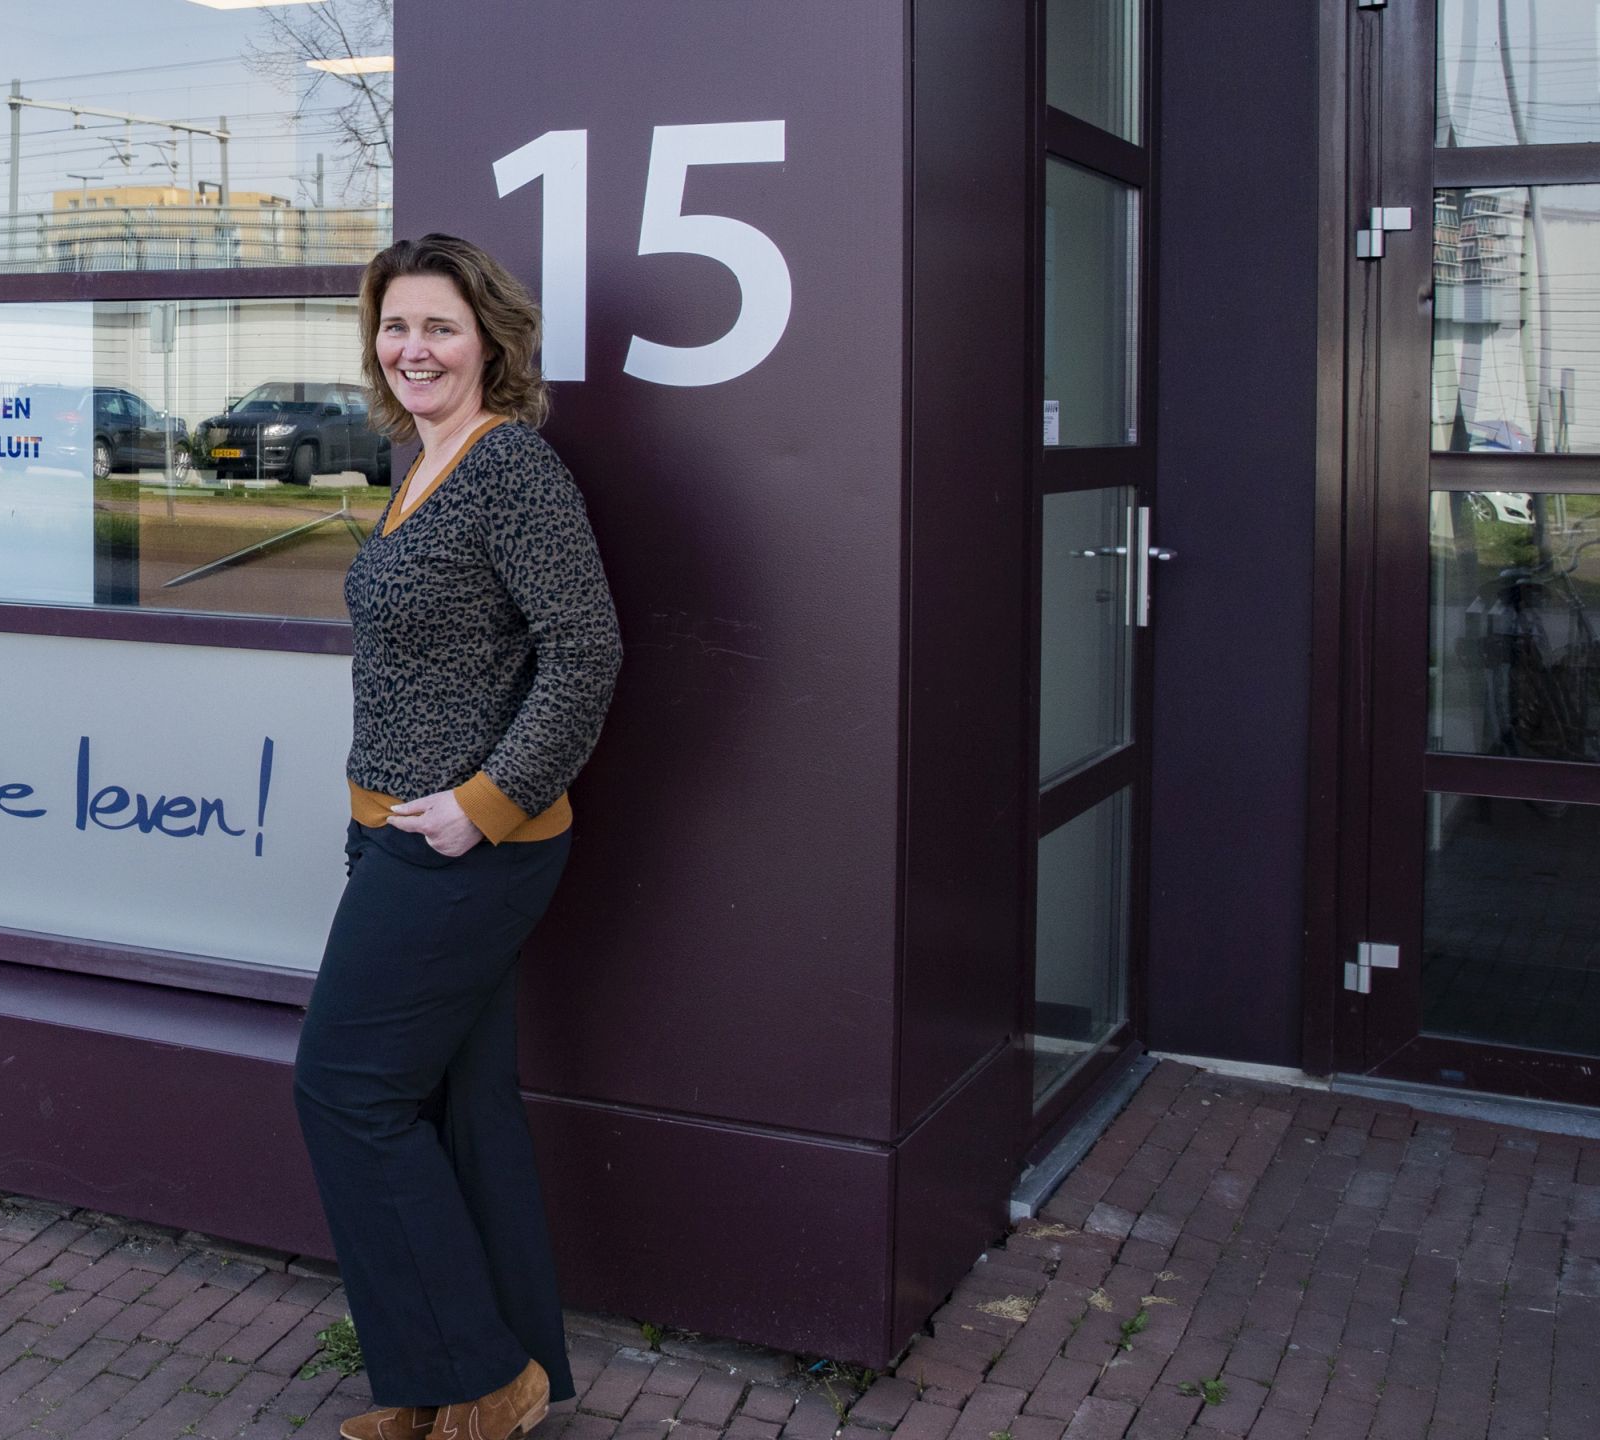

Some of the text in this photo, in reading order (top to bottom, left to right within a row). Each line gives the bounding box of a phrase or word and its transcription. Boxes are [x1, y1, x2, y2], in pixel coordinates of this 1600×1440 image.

[492, 119, 792, 387] 15
[2, 397, 31, 419] EN
[75, 736, 274, 857] leven!
